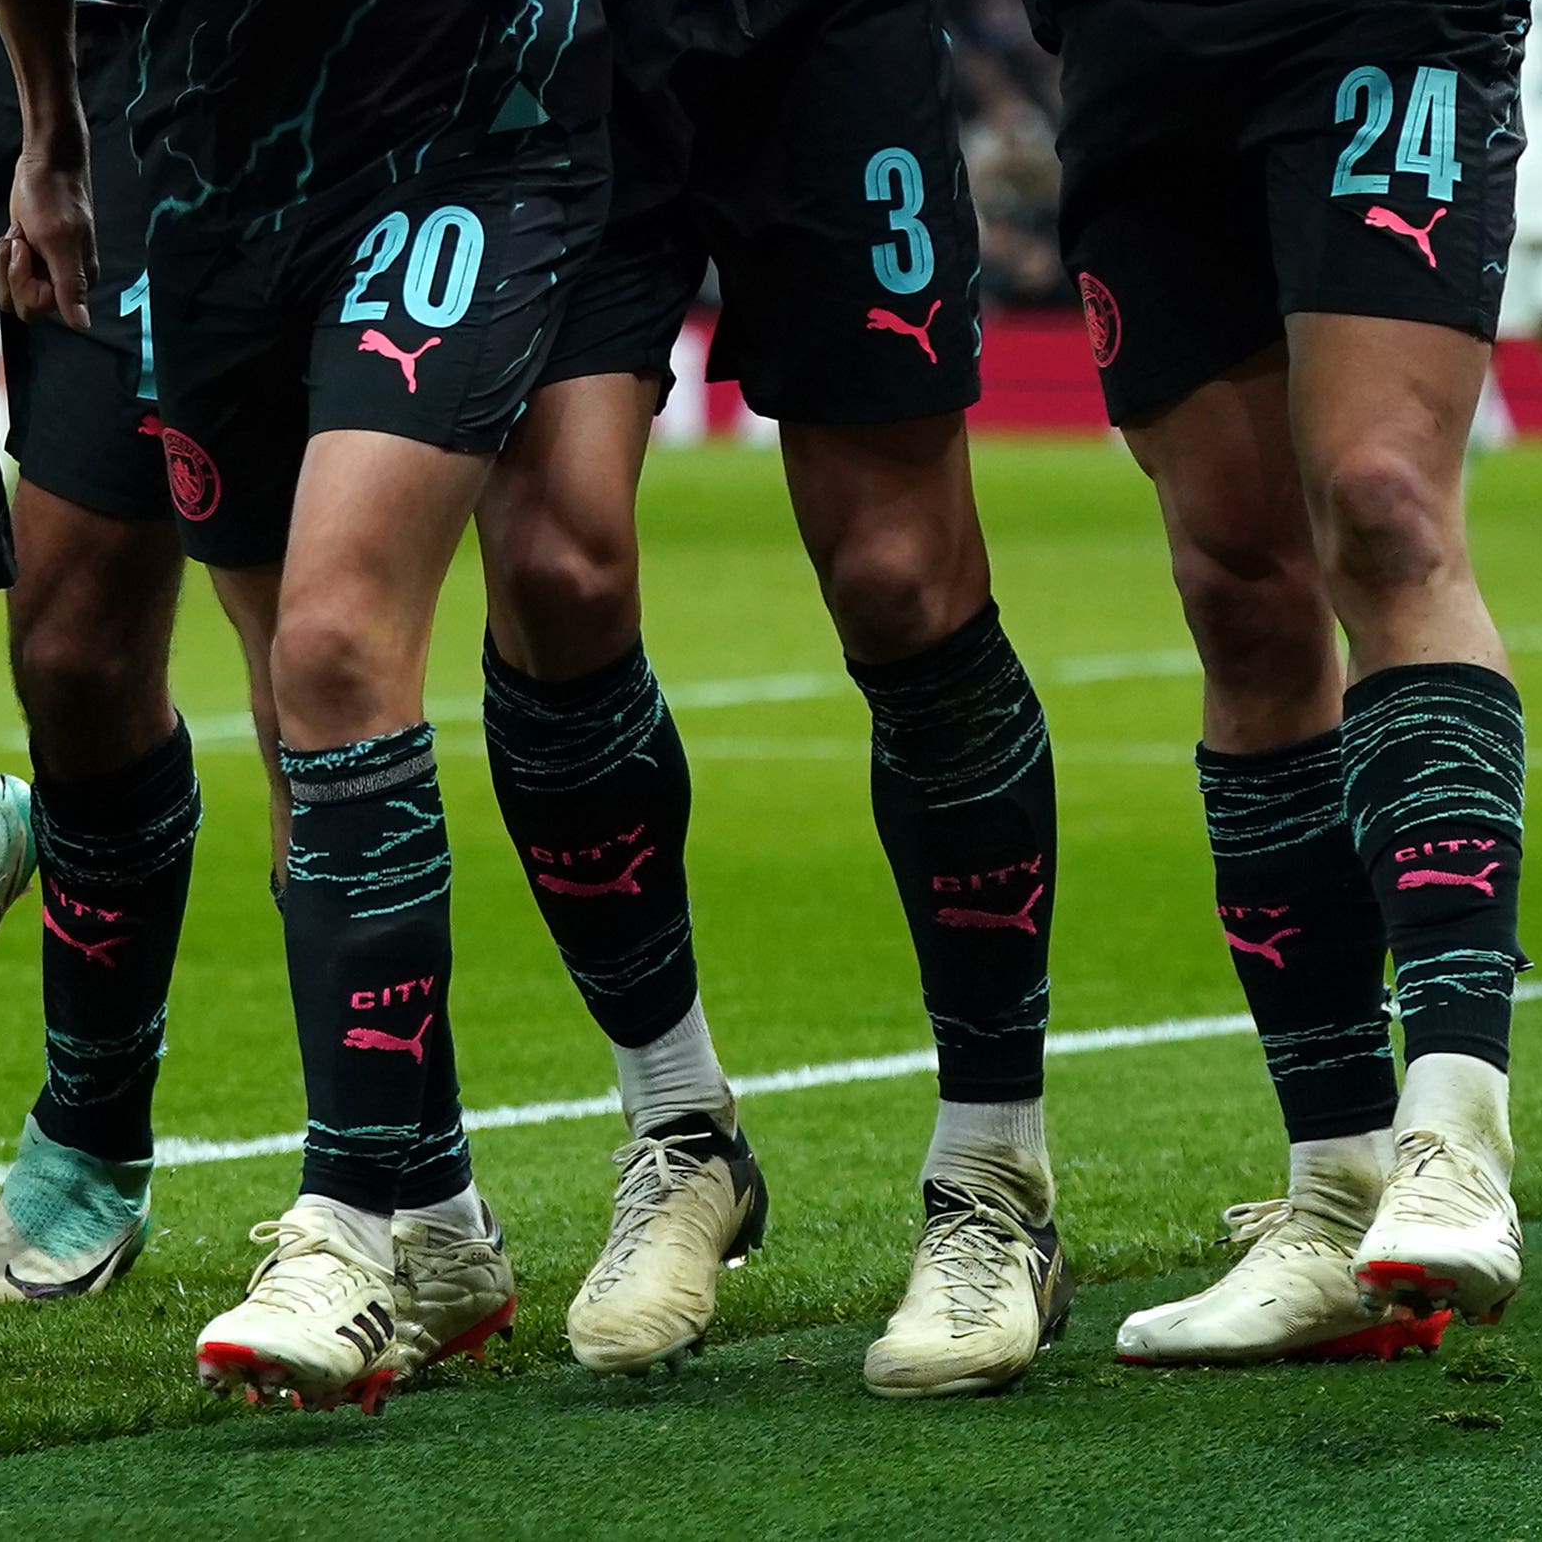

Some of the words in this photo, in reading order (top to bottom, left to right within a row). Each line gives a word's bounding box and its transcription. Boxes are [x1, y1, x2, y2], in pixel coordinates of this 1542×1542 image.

[1331, 66, 1461, 202] 24
[339, 205, 485, 328] 20
[865, 146, 935, 295] 3
[1394, 837, 1497, 863] CITY
[351, 975, 435, 1010] CITY
